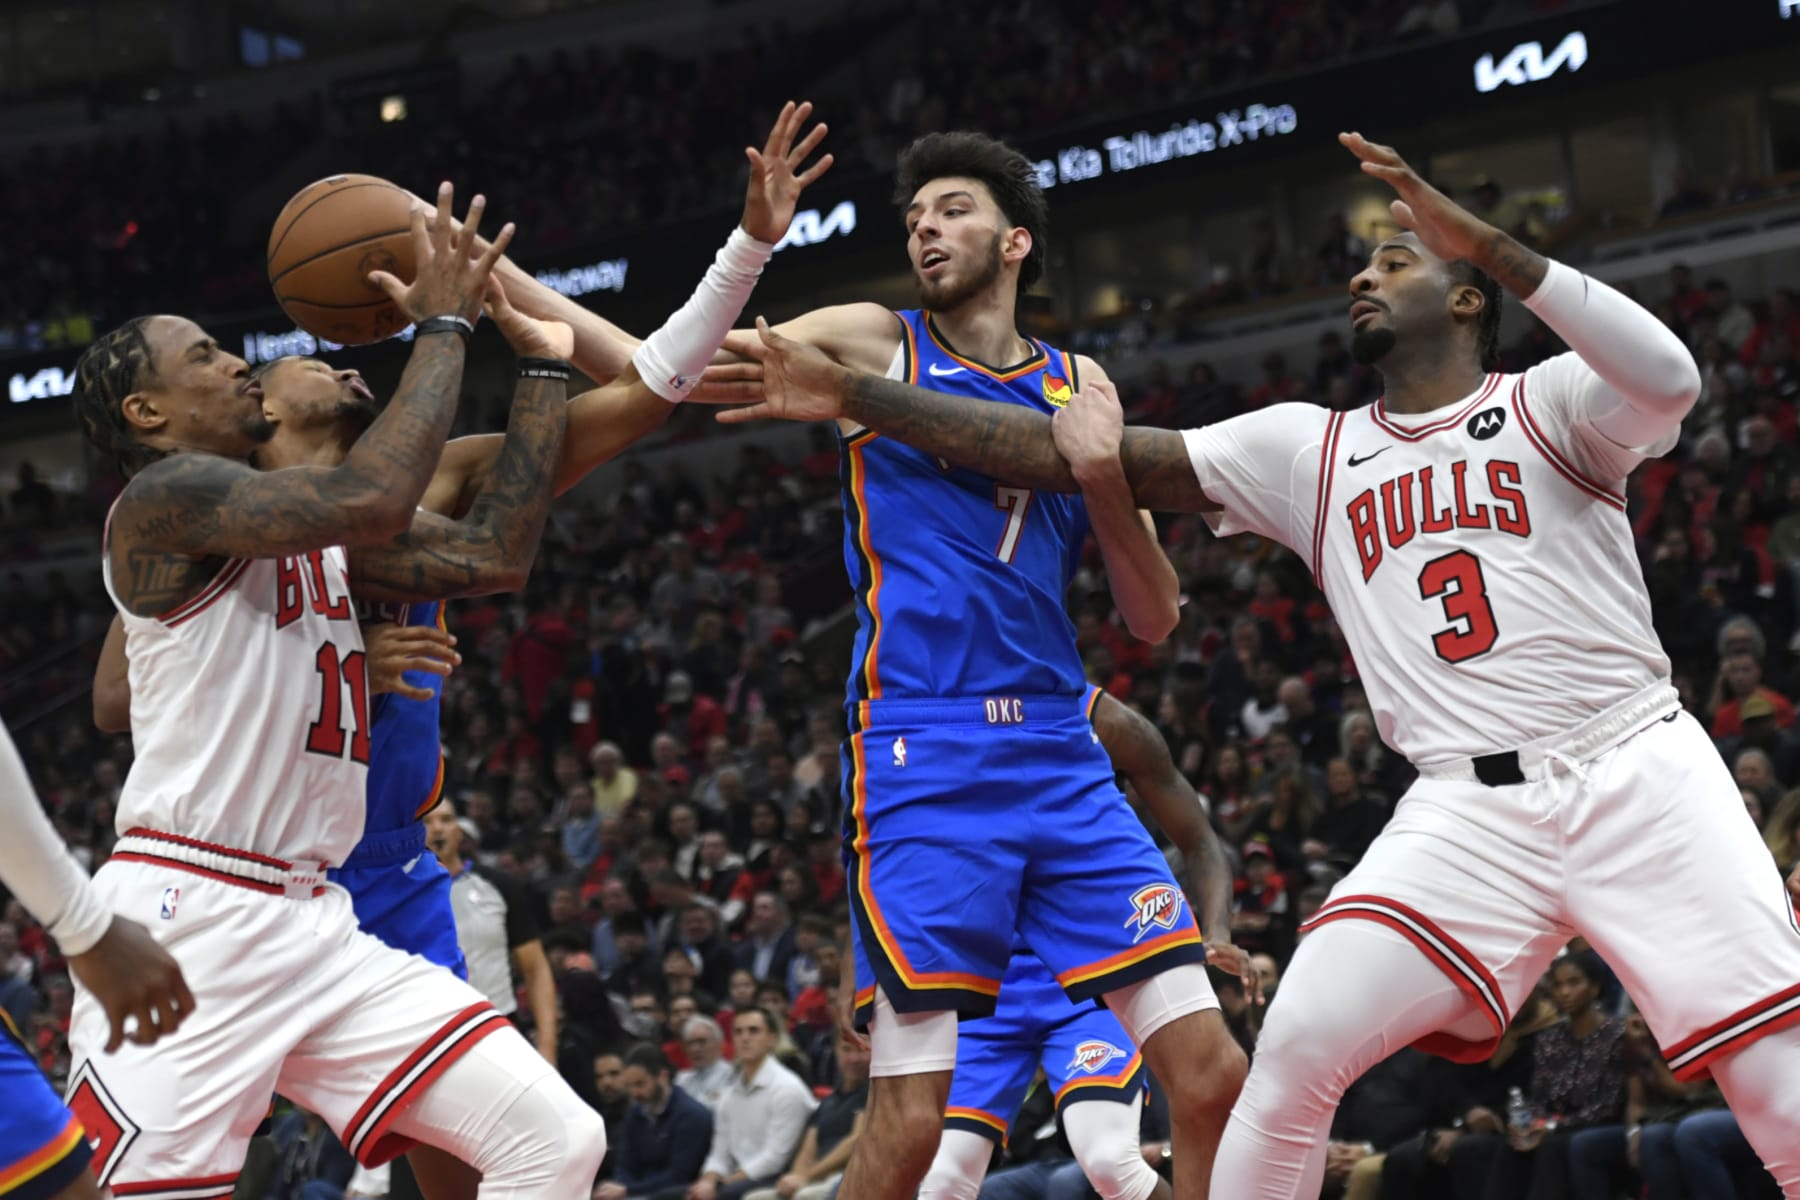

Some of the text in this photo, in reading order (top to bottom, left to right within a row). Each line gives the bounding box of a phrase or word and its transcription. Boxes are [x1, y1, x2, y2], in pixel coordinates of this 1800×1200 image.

[1216, 102, 1298, 148] X-Pro
[995, 481, 1035, 566] 7
[1346, 459, 1531, 585] BULLS
[1417, 548, 1499, 665] 3
[305, 640, 371, 766] 11
[984, 698, 1025, 725] OKC
[1141, 891, 1171, 927] OKC
